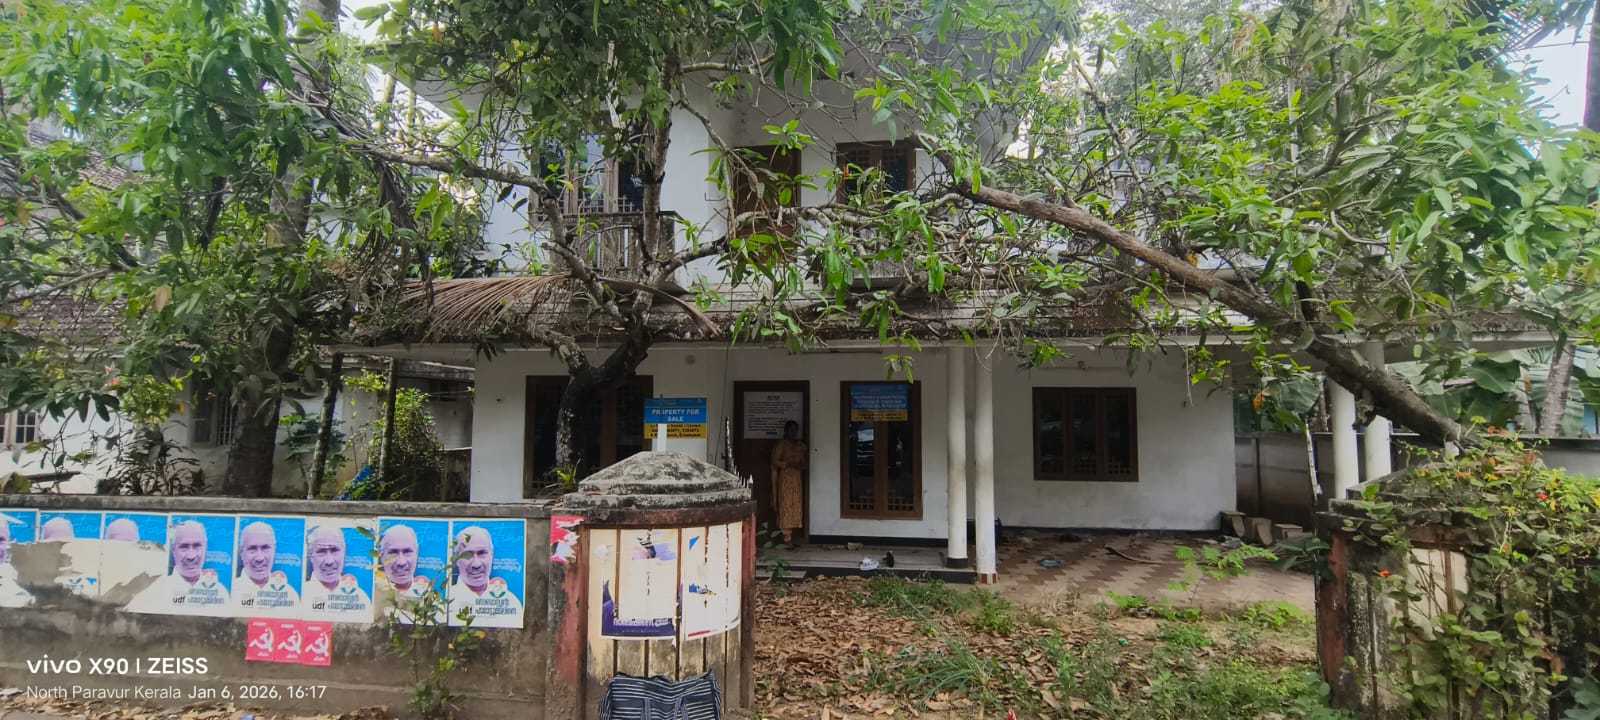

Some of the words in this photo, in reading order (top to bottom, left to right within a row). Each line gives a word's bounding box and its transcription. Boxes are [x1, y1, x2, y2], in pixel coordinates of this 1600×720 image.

[173, 596, 186, 604] udf
[241, 598, 255, 606] udf
[312, 601, 325, 610] udf
[459, 606, 473, 615] uf
